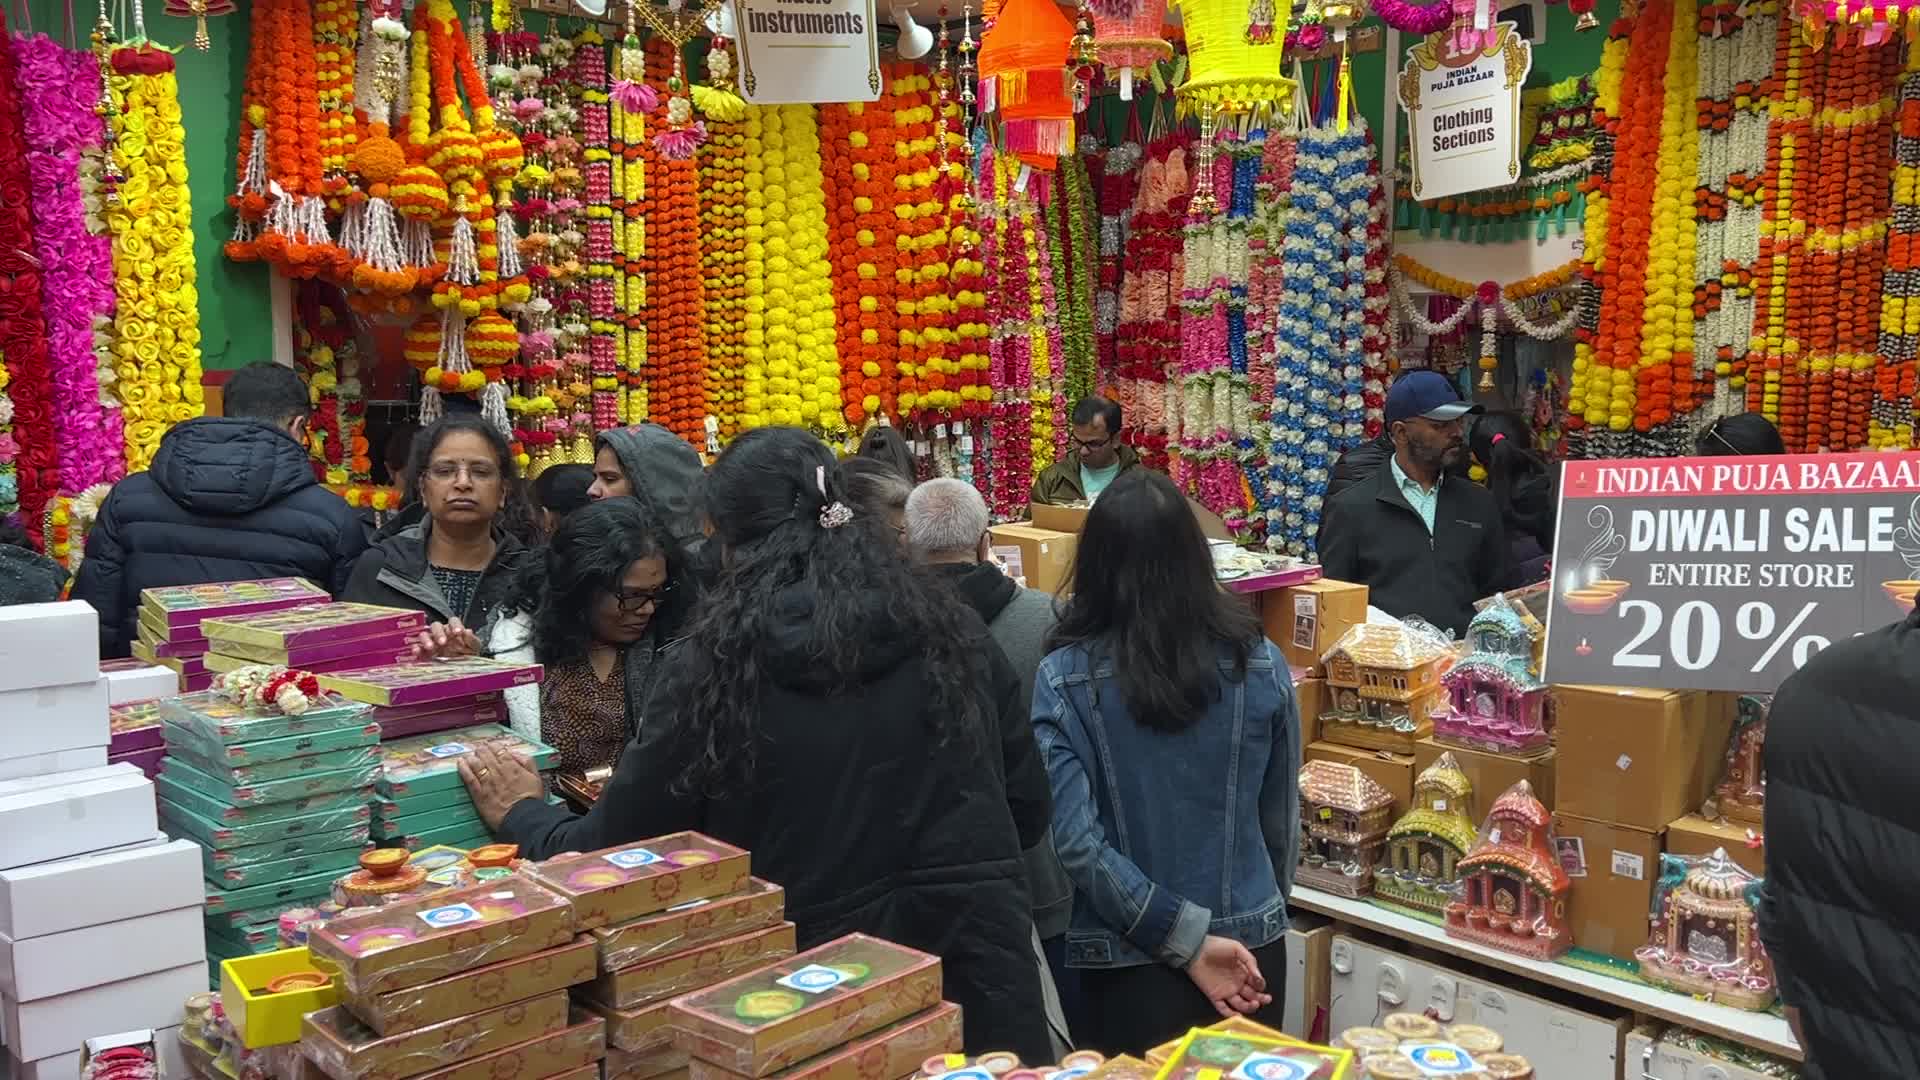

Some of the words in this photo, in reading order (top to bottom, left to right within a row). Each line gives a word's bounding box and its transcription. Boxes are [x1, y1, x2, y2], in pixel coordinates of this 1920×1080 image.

[748, 8, 863, 34] instruments
[1431, 80, 1454, 92] PUJA
[1457, 70, 1494, 86] BAZAAR
[1446, 65, 1477, 79] INDIAN
[1433, 107, 1493, 132] Clothing
[1432, 127, 1495, 152] Sections
[1596, 465, 1705, 493] INDIAN
[1712, 463, 1794, 491] PUJA
[1799, 460, 1920, 489] BAZAA
[1629, 508, 1770, 553] DIWALI
[1784, 506, 1895, 552] SALE
[1648, 563, 1751, 587] ENTIRE
[1759, 564, 1855, 589] STORE
